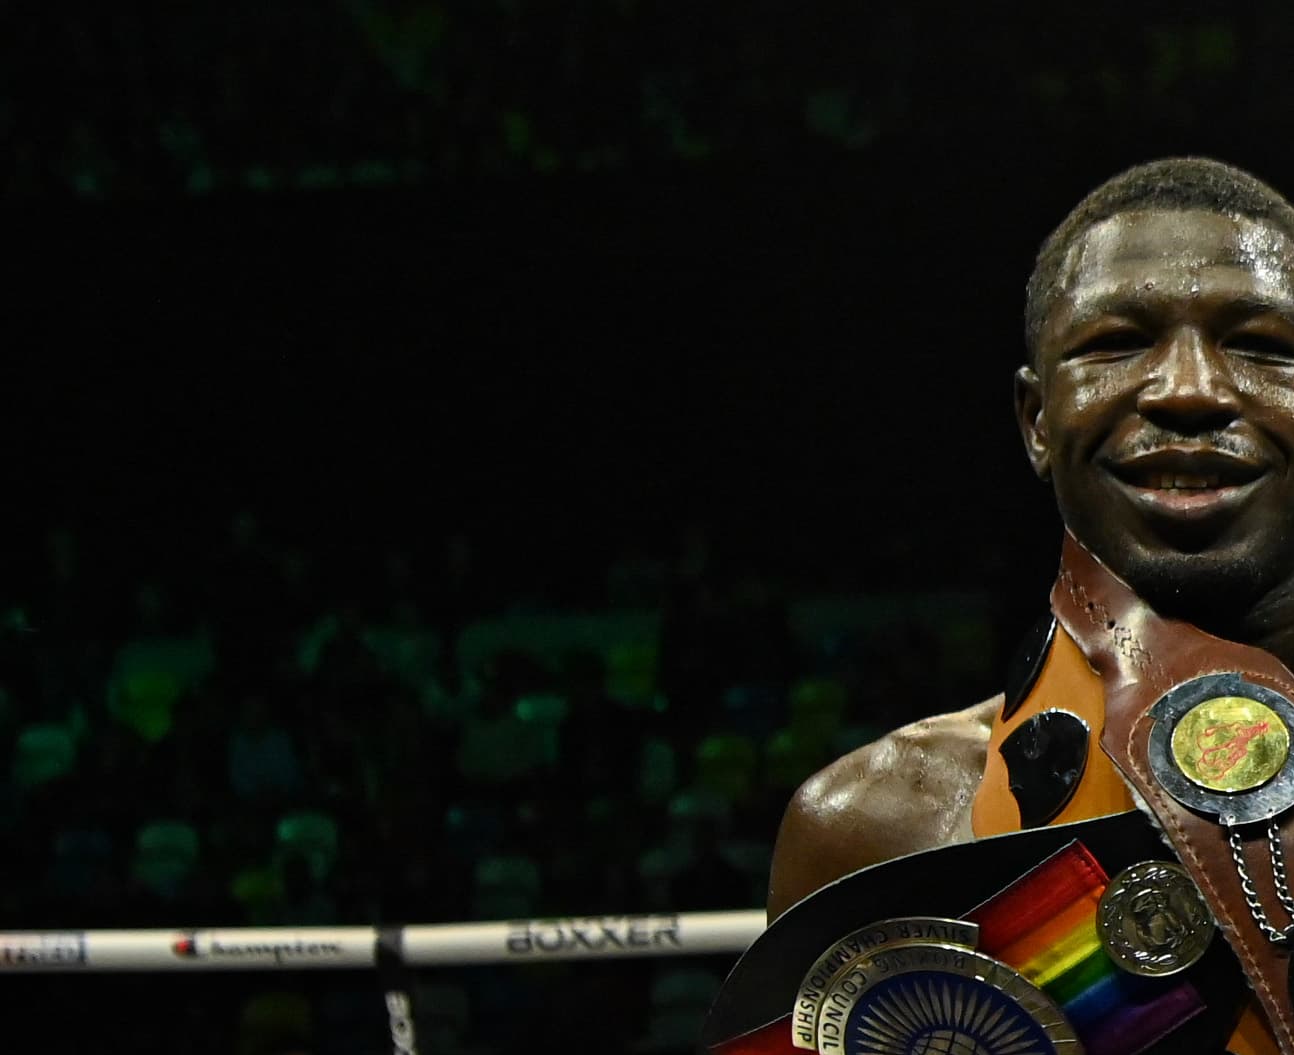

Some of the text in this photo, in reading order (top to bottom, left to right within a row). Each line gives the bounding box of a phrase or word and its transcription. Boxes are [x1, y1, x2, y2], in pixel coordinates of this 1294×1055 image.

[507, 914, 684, 953] BOXXER
[794, 922, 972, 1044] SILVER CHAMPIONSHIP
[819, 946, 968, 1051] BOXING COUNCIL
